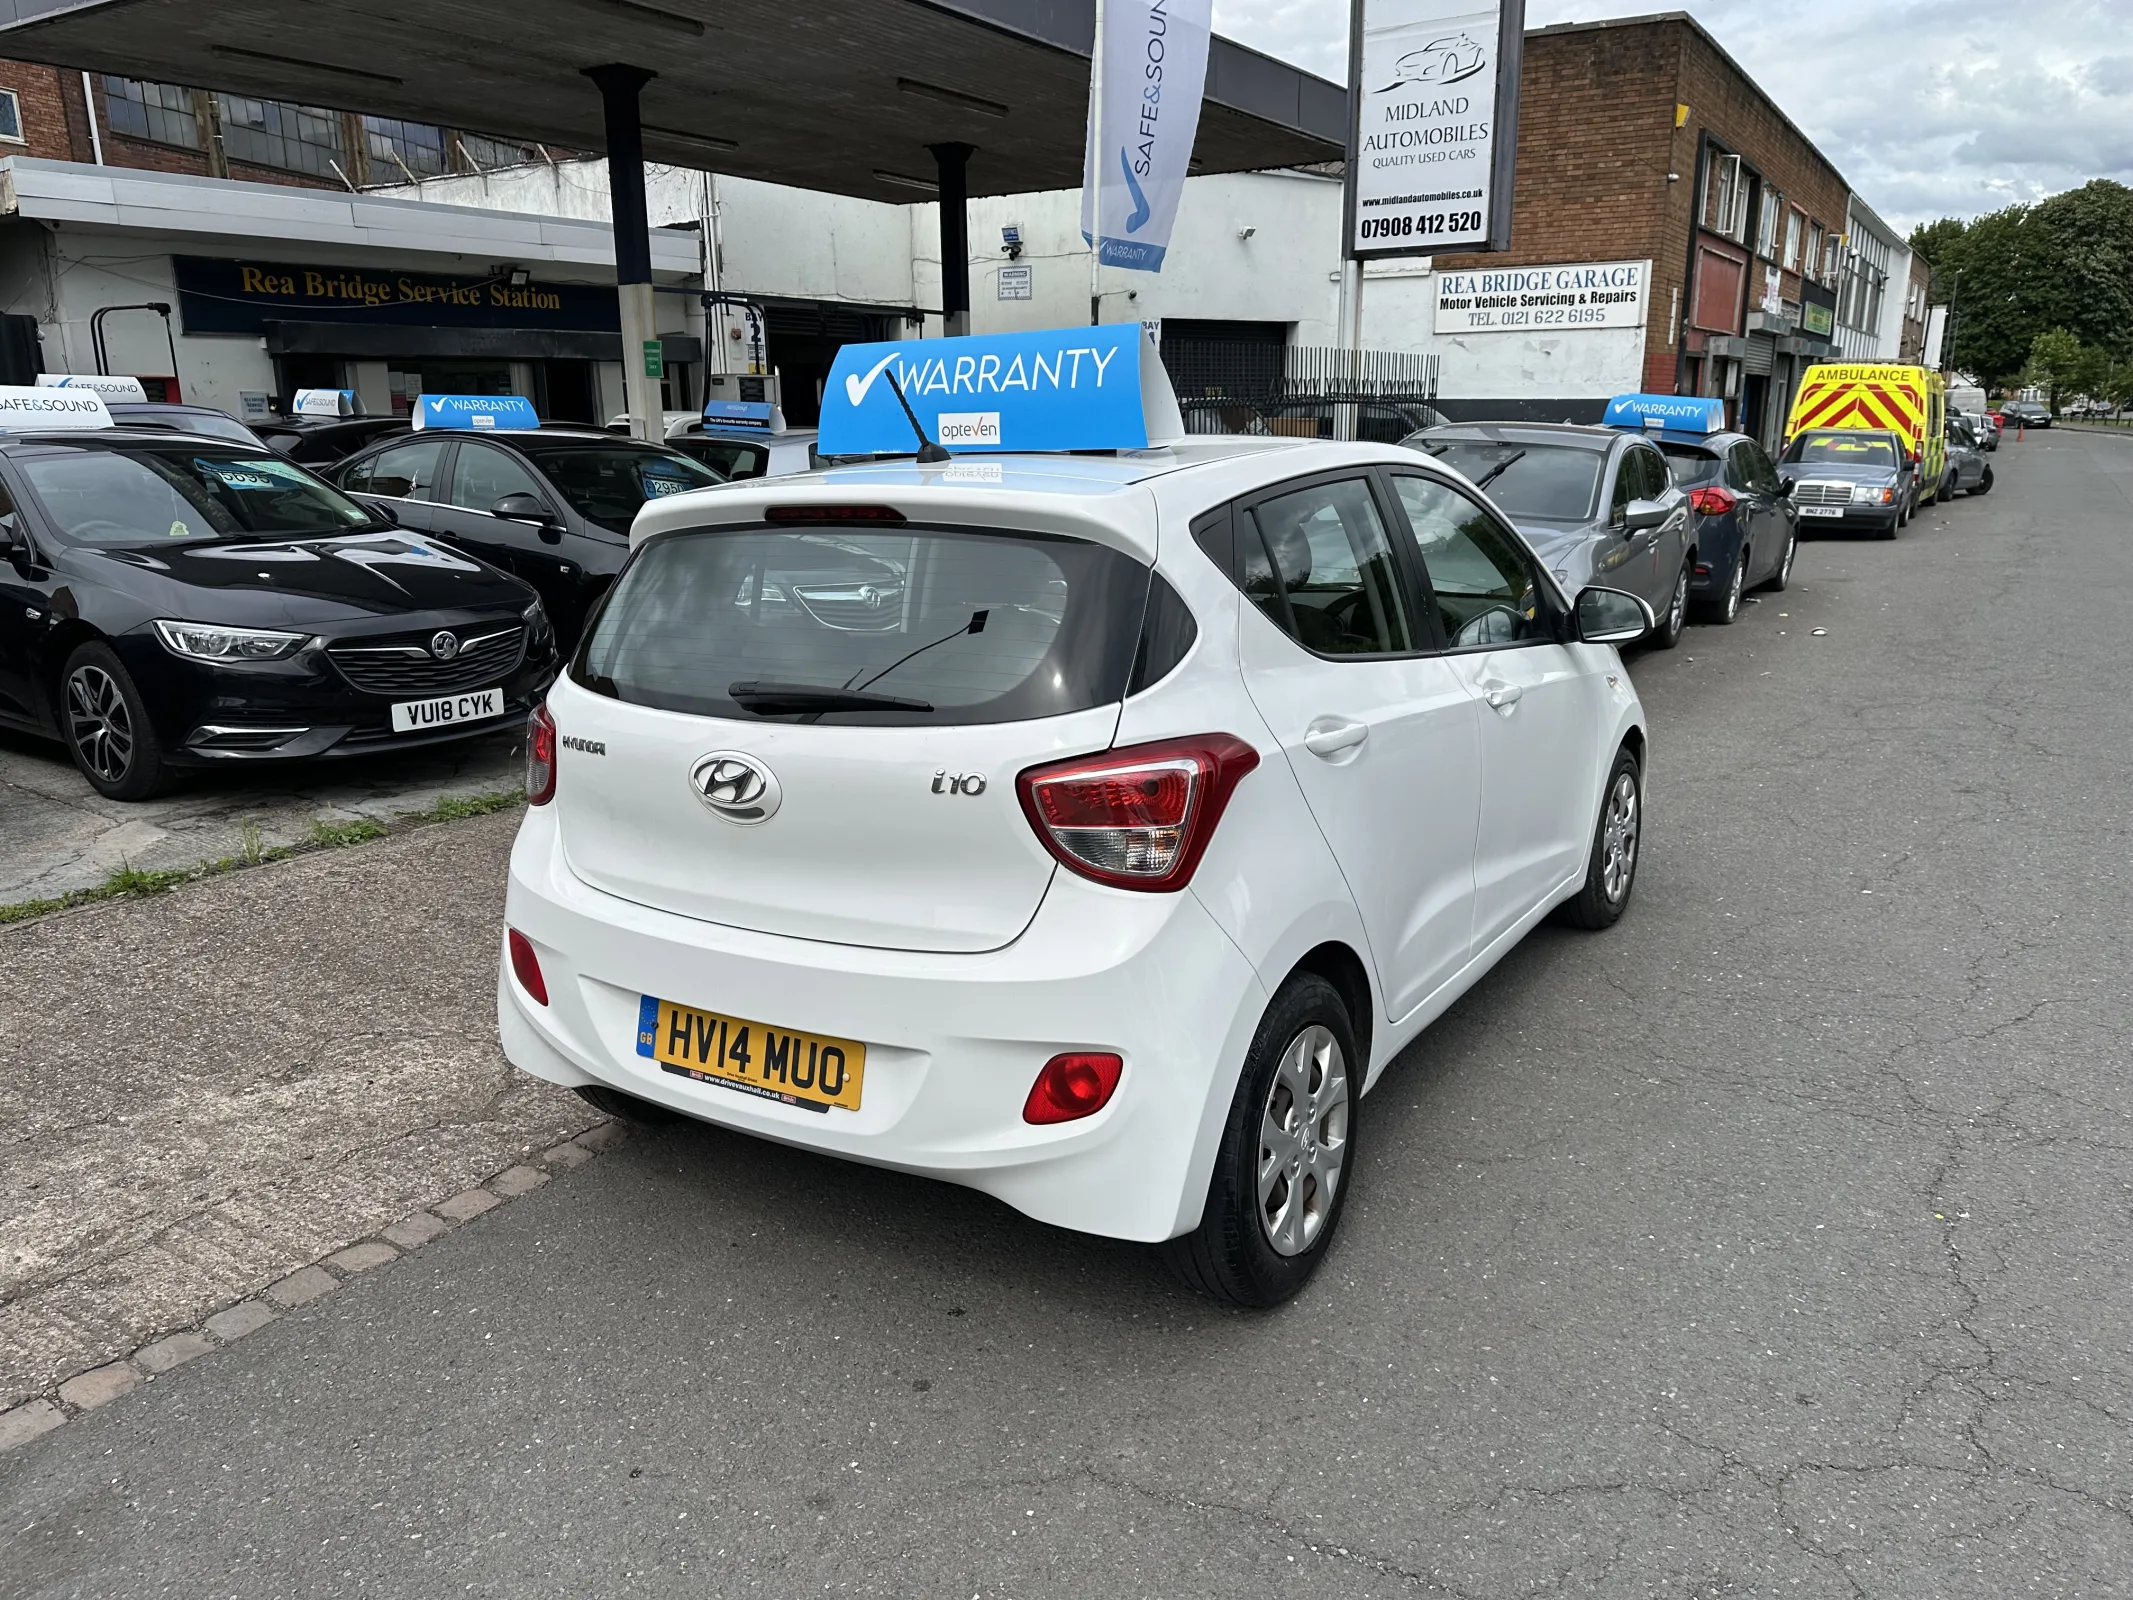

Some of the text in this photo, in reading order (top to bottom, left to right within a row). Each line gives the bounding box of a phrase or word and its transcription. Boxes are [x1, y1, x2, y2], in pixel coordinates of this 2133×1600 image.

[1135, 0, 1167, 176] SAFE&SOUN
[1385, 97, 1469, 122] MIDLAND
[1364, 123, 1488, 151] AUTOMOBILES
[1373, 148, 1476, 168] QUALITY USED CARS
[1363, 188, 1483, 207] www.midlandautomobiles.co.uk
[1361, 211, 1481, 238] 07908 412 520
[1106, 243, 1148, 260] WARRANTY
[240, 266, 561, 309] Rea Bridge Service Station
[1441, 267, 1638, 295] REA BRIDGE GARAGE
[1440, 290, 1637, 310] Motor Vehicle Servicing & Repairs
[745, 312, 762, 321] BY
[1468, 308, 1606, 326] TEL. 0121 622 6195
[899, 346, 1118, 396] WARRANTY
[1816, 369, 1910, 381] AMBULANCE
[304, 397, 337, 407] SAFE&SOUND
[449, 399, 524, 412] WARRANTY
[1632, 402, 1702, 418] WARRANTY
[941, 417, 998, 440] opteven
[407, 693, 493, 725] VU18 CYK
[562, 735, 606, 756] HYUNDAI
[931, 768, 987, 796] i10
[640, 1031, 653, 1045] GB
[668, 1010, 846, 1096] HV14 MUO
[705, 1074, 780, 1100] www.drivevauxhall.co.uk
